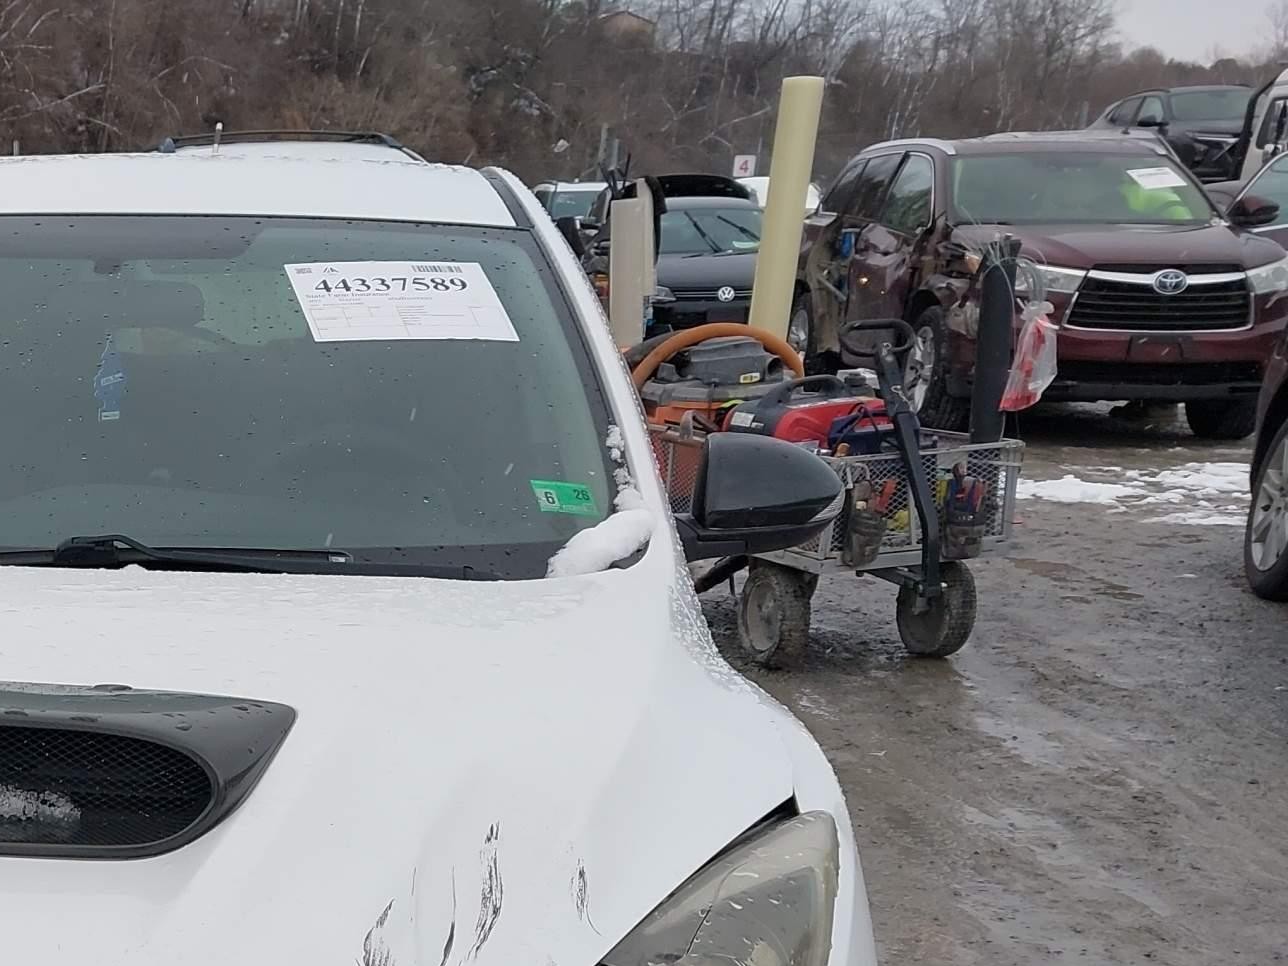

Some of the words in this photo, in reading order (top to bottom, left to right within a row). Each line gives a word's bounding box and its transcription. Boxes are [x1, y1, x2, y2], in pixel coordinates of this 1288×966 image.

[739, 159, 749, 174] 4
[314, 277, 468, 293] 44337589
[544, 491, 556, 505] 6
[573, 489, 590, 501] 26
